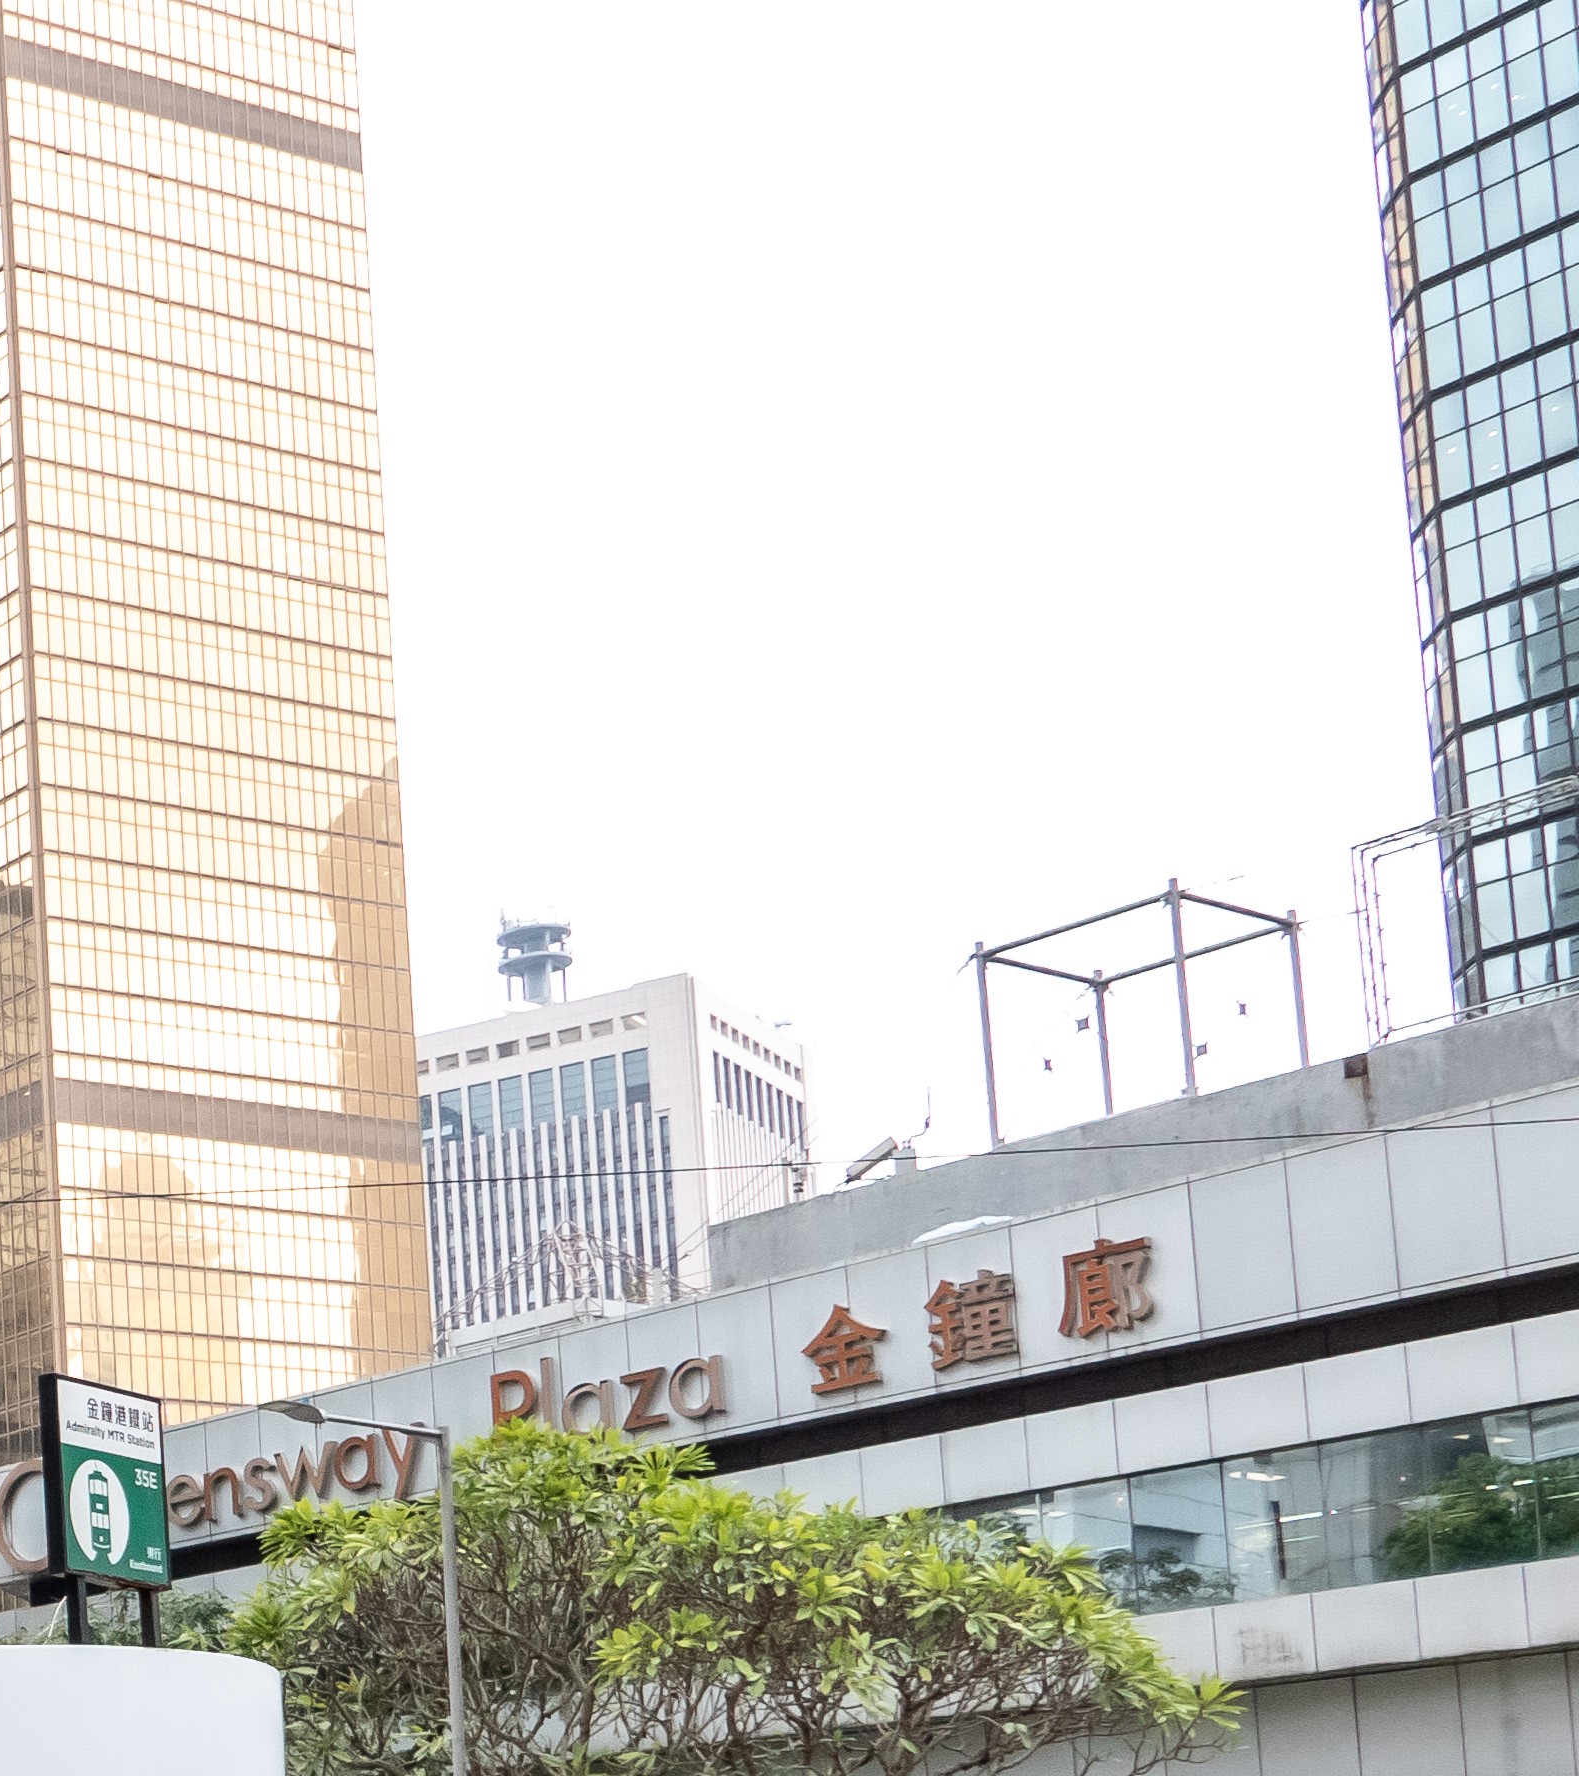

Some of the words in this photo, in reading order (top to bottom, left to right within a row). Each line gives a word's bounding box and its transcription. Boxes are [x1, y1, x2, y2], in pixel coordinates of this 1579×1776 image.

[490, 1353, 727, 1433] Plaza
[801, 1237, 1156, 1396] 金鐘廊
[86, 1397, 154, 1433] 金鐘港鐵站
[65, 1419, 105, 1440] Admiralty
[107, 1430, 125, 1444] MTR
[127, 1433, 156, 1449] Station
[134, 1468, 158, 1489] 35E
